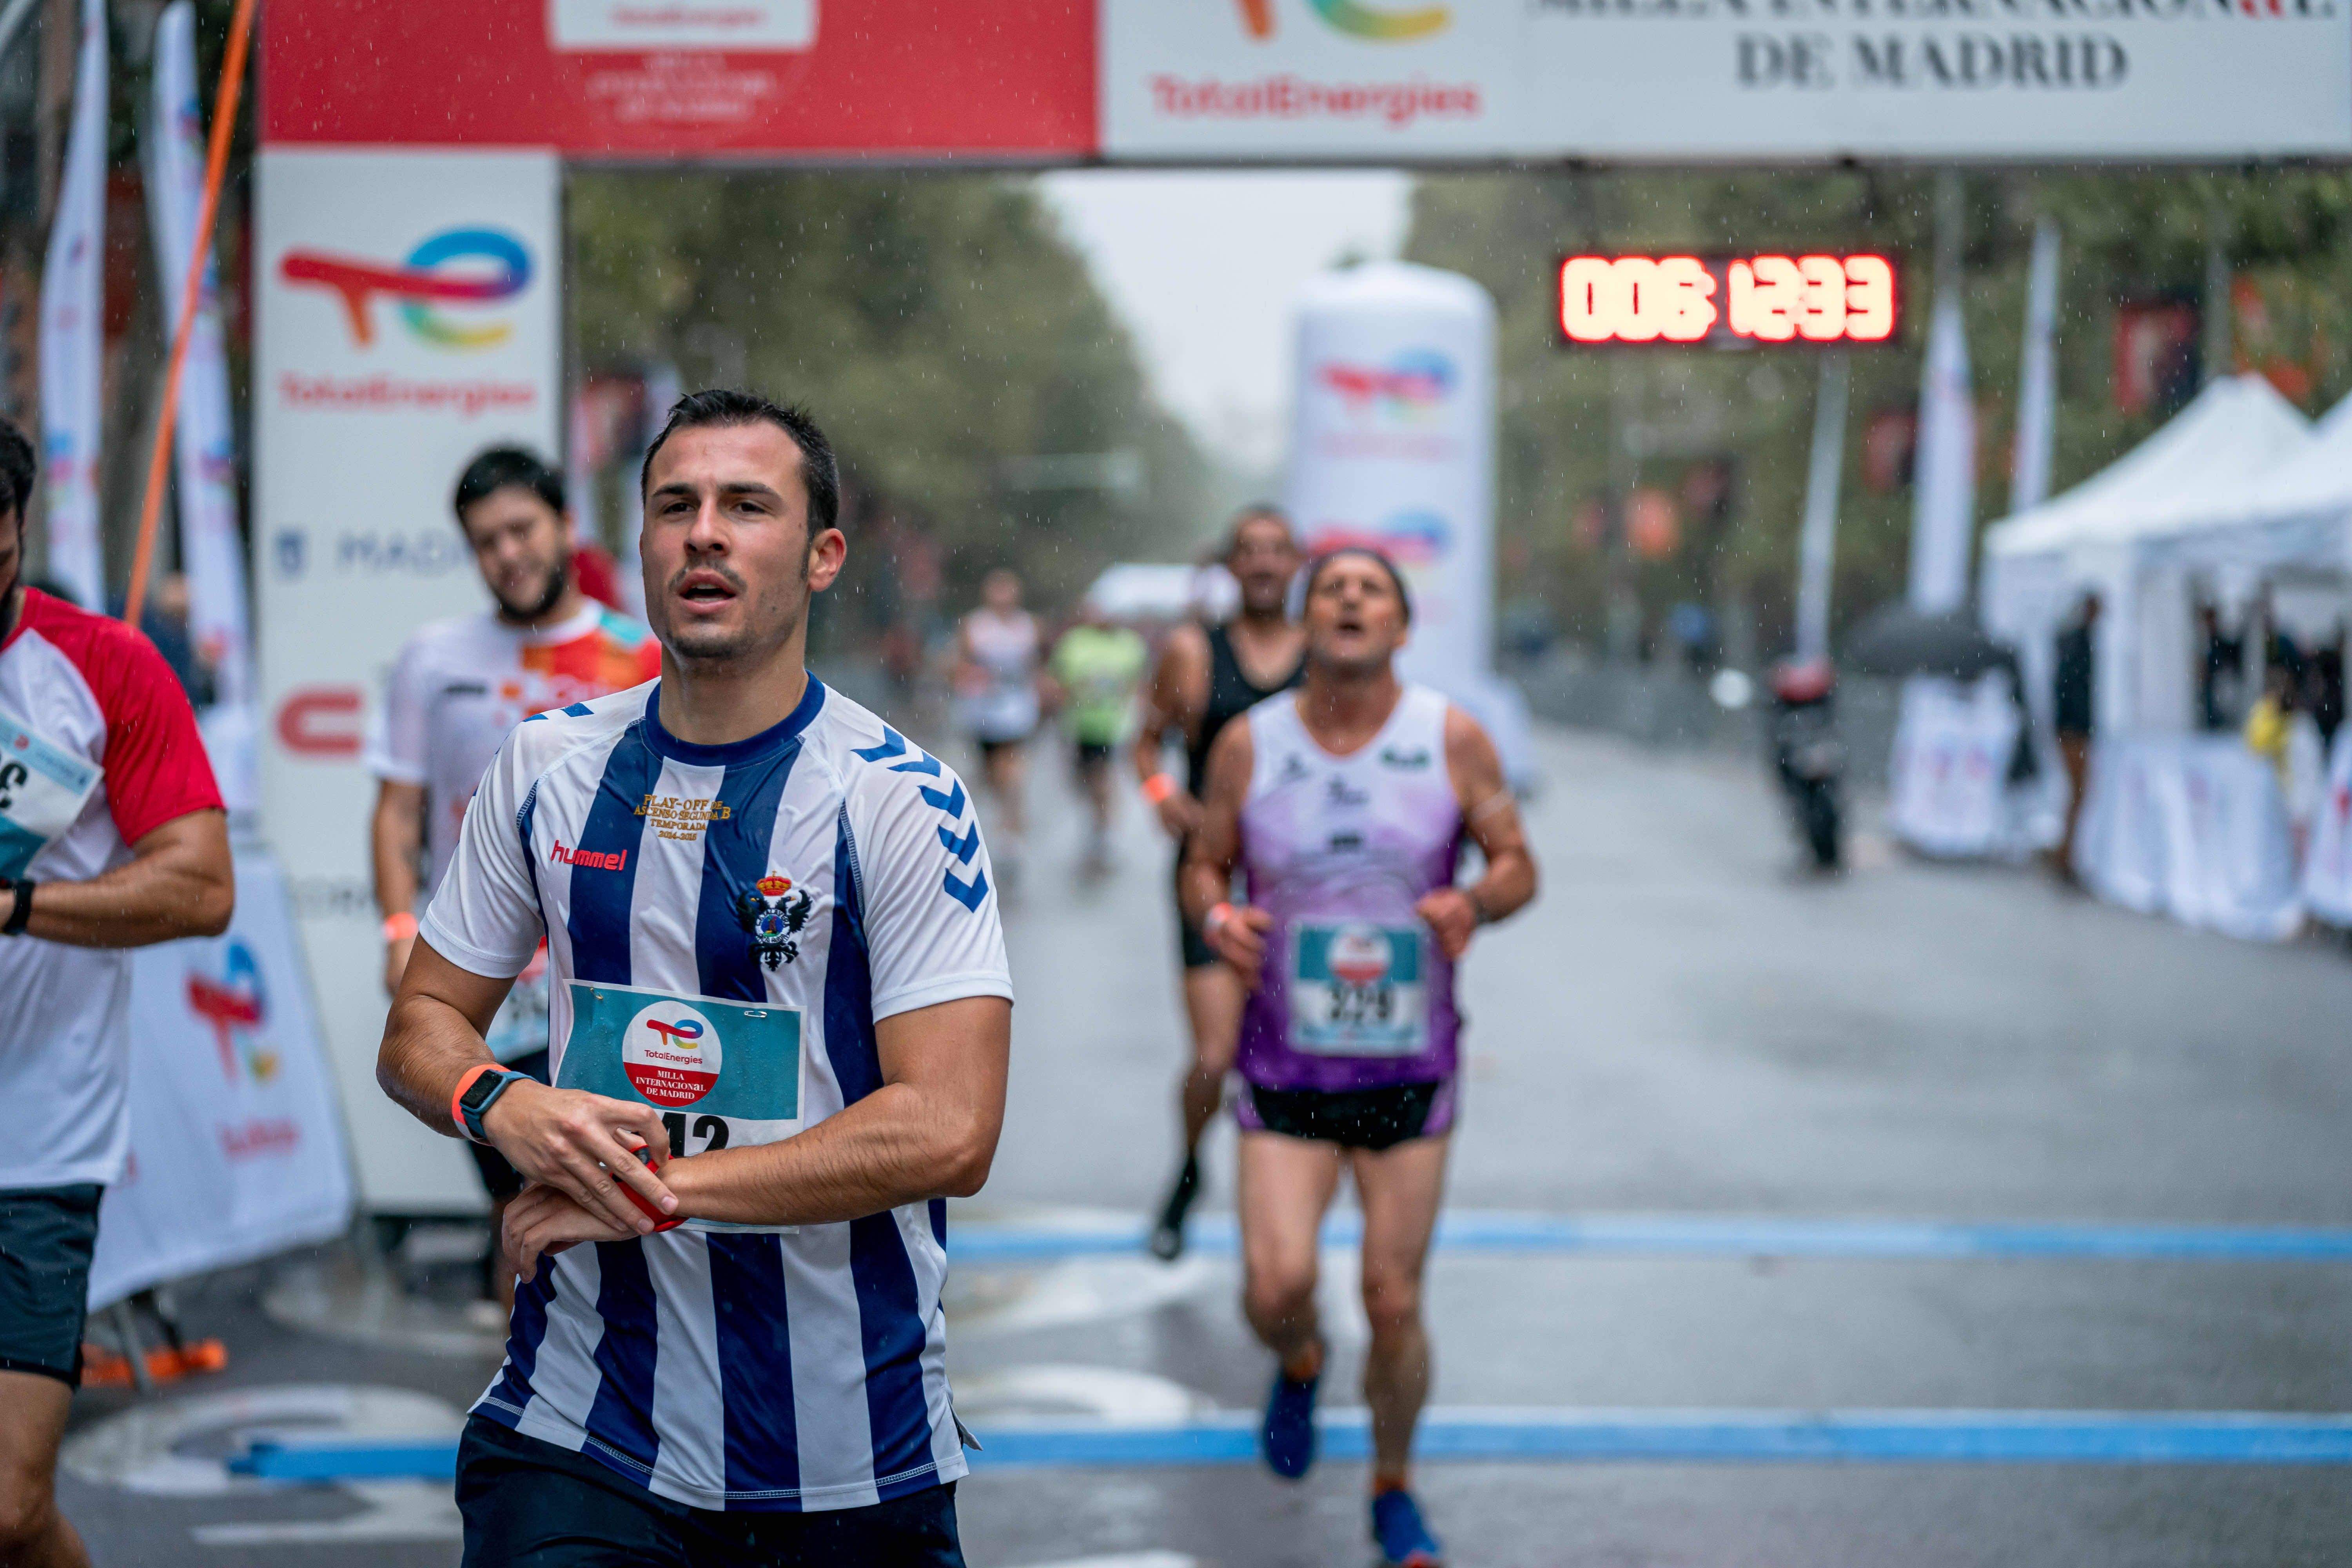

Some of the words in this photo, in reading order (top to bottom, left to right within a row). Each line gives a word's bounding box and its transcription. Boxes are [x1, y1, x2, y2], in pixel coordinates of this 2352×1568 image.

[1735, 31, 1836, 90] DE
[1851, 30, 2130, 90] MADRID
[1151, 73, 1481, 129] TotalEnergies
[644, 794, 710, 810] PLAY-OFF
[711, 801, 723, 809] DE
[633, 805, 677, 819] ASCENSO
[678, 811, 718, 820] SEGUNDA
[721, 807, 731, 819] B
[650, 818, 706, 831] TEMPORADA
[550, 840, 627, 871] hummel
[644, 1049, 703, 1065] TotalEnergies
[657, 1070, 684, 1080] MILLA
[646, 1087, 658, 1095] DE
[659, 1089, 695, 1099] MADRID
